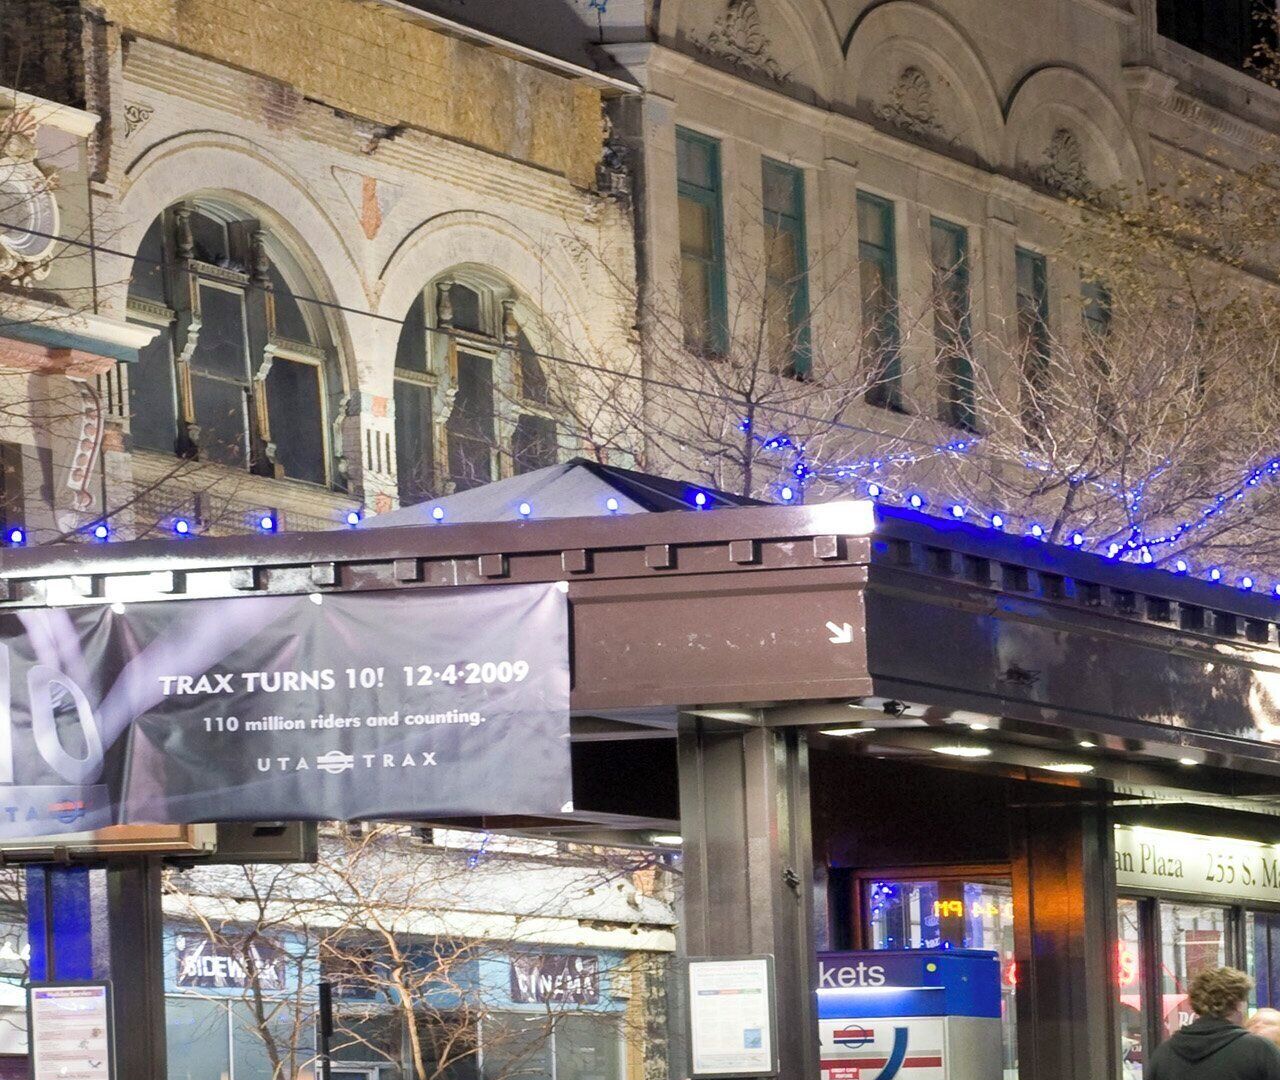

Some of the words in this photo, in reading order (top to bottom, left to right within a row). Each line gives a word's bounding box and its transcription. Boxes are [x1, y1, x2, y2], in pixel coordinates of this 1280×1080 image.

[159, 674, 234, 695] TRAX
[242, 669, 336, 692] TURNS
[346, 667, 385, 688] 10!
[203, 717, 239, 732] 110
[245, 714, 305, 732] million
[310, 714, 361, 729] riders
[366, 712, 399, 727] and
[404, 709, 486, 729] counting.
[257, 757, 309, 772] UTA
[363, 751, 437, 768] TRAX
[1115, 850, 1134, 873] an
[1139, 843, 1184, 878] Plaza
[818, 961, 886, 987] kets
